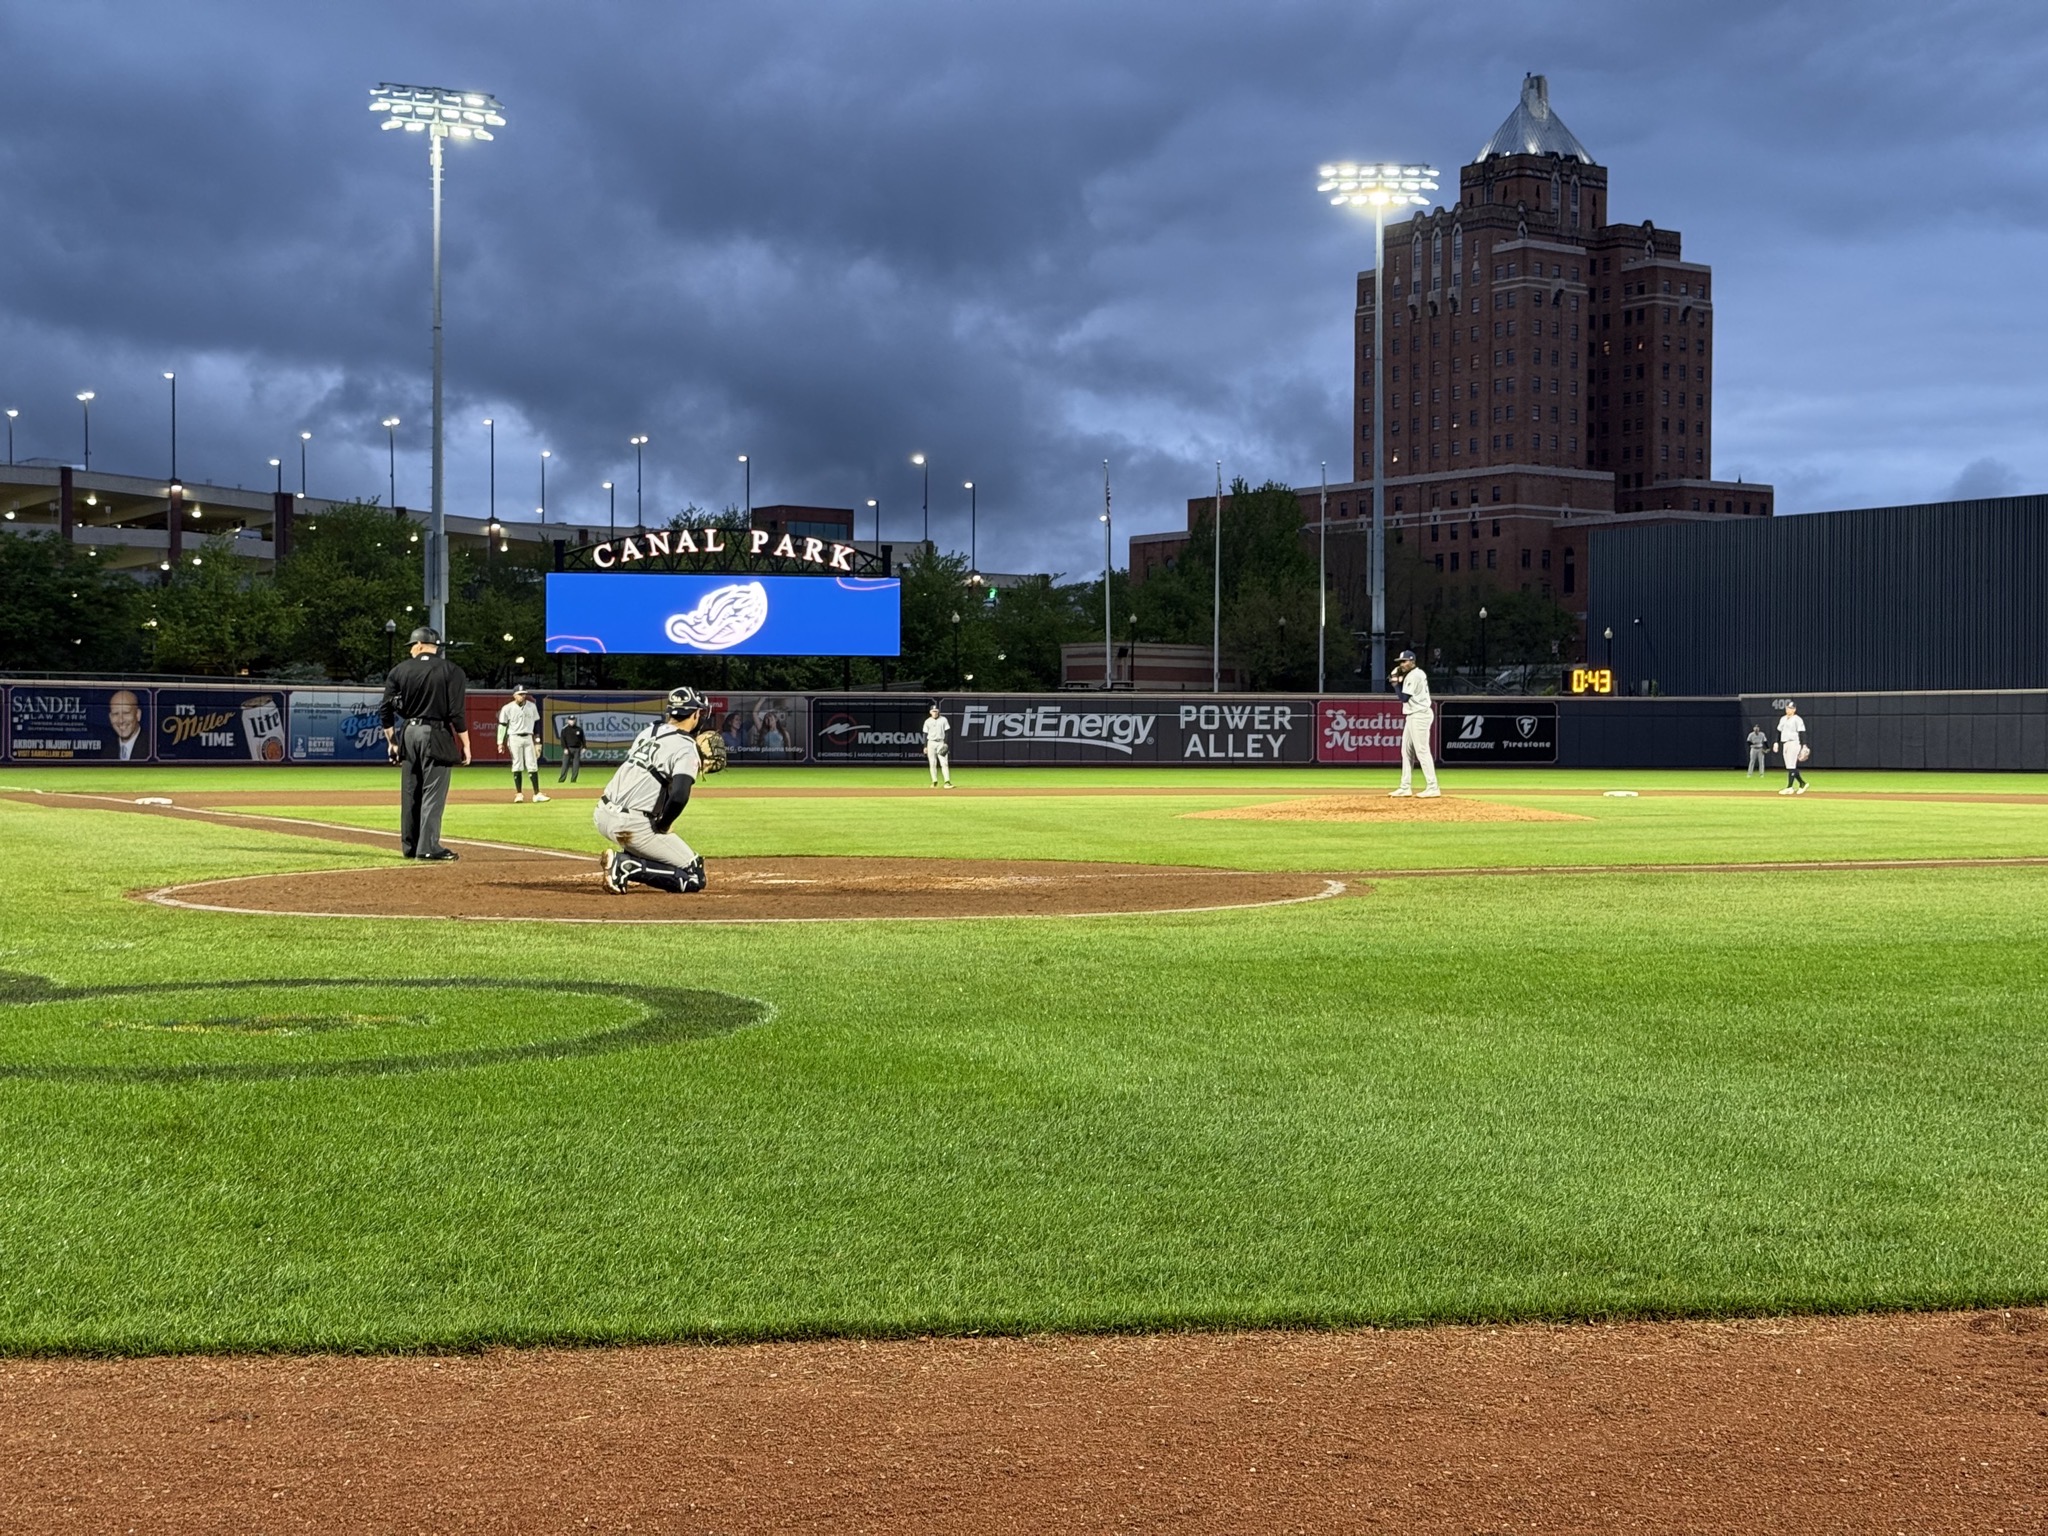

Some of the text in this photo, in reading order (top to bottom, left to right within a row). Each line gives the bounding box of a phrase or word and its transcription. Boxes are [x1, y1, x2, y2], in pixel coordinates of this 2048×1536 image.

[593, 529, 855, 571] CANAL PARK
[1572, 669, 1611, 693] 0:43
[12, 696, 86, 713] SANDEL
[175, 704, 195, 715] IT'S
[249, 710, 280, 738] Lite
[1180, 705, 1293, 730] POWER
[162, 712, 236, 745] Miller
[73, 740, 101, 750] LAWYER
[200, 732, 234, 747] TIME
[858, 732, 926, 745] MORGAN
[1184, 733, 1287, 758] ALLEY
[1446, 741, 1496, 749] BRIDGESTONE
[1502, 740, 1551, 749] Firestone
